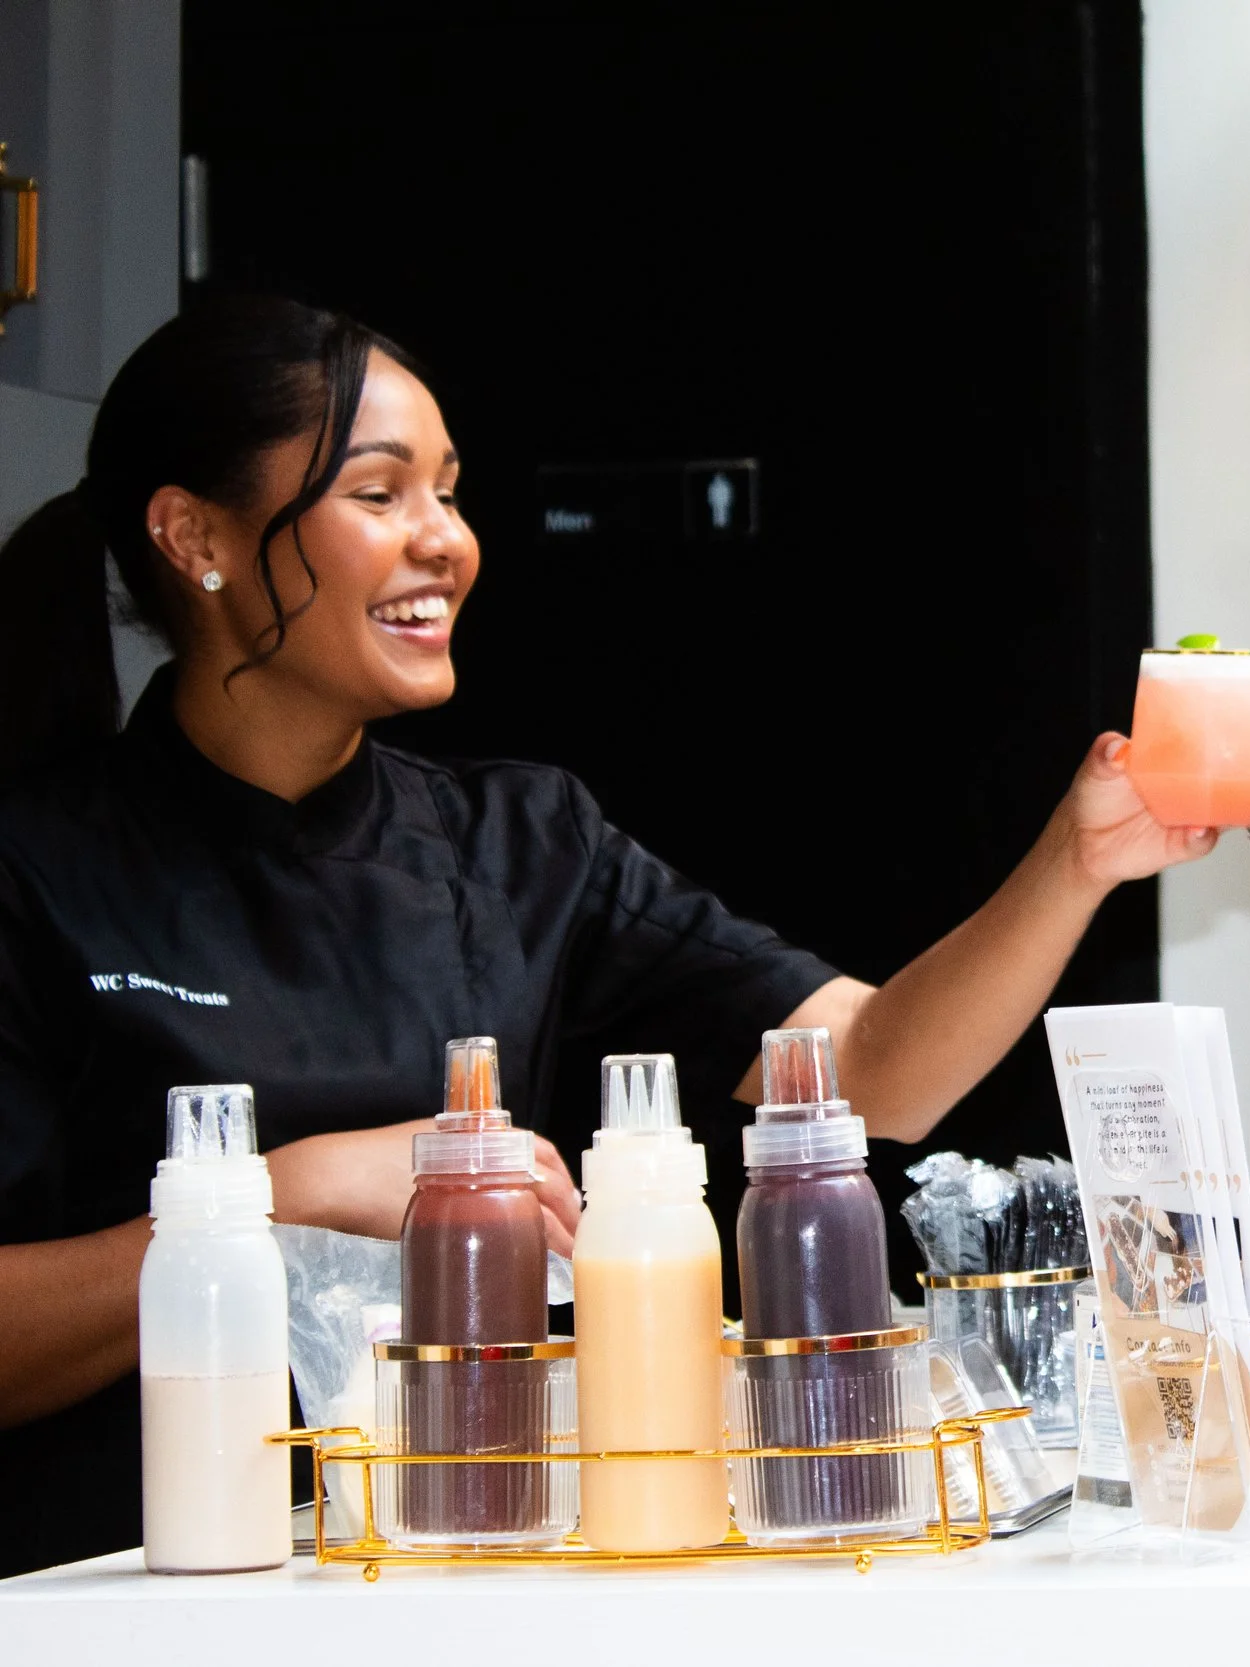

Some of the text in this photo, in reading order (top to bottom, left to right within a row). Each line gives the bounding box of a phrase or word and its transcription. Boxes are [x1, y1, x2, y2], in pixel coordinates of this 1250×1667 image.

[90, 972, 229, 1006] WC Sweet Treats
[1086, 1085, 1091, 1096] A
[1107, 1085, 1120, 1095] loaf
[1121, 1084, 1128, 1093] of
[1129, 1083, 1164, 1096] happiness
[1105, 1101, 1122, 1110] turns
[1123, 1100, 1136, 1112] any
[1137, 1098, 1165, 1109] moment
[1153, 1129, 1159, 1138] is
[1161, 1130, 1166, 1138] a
